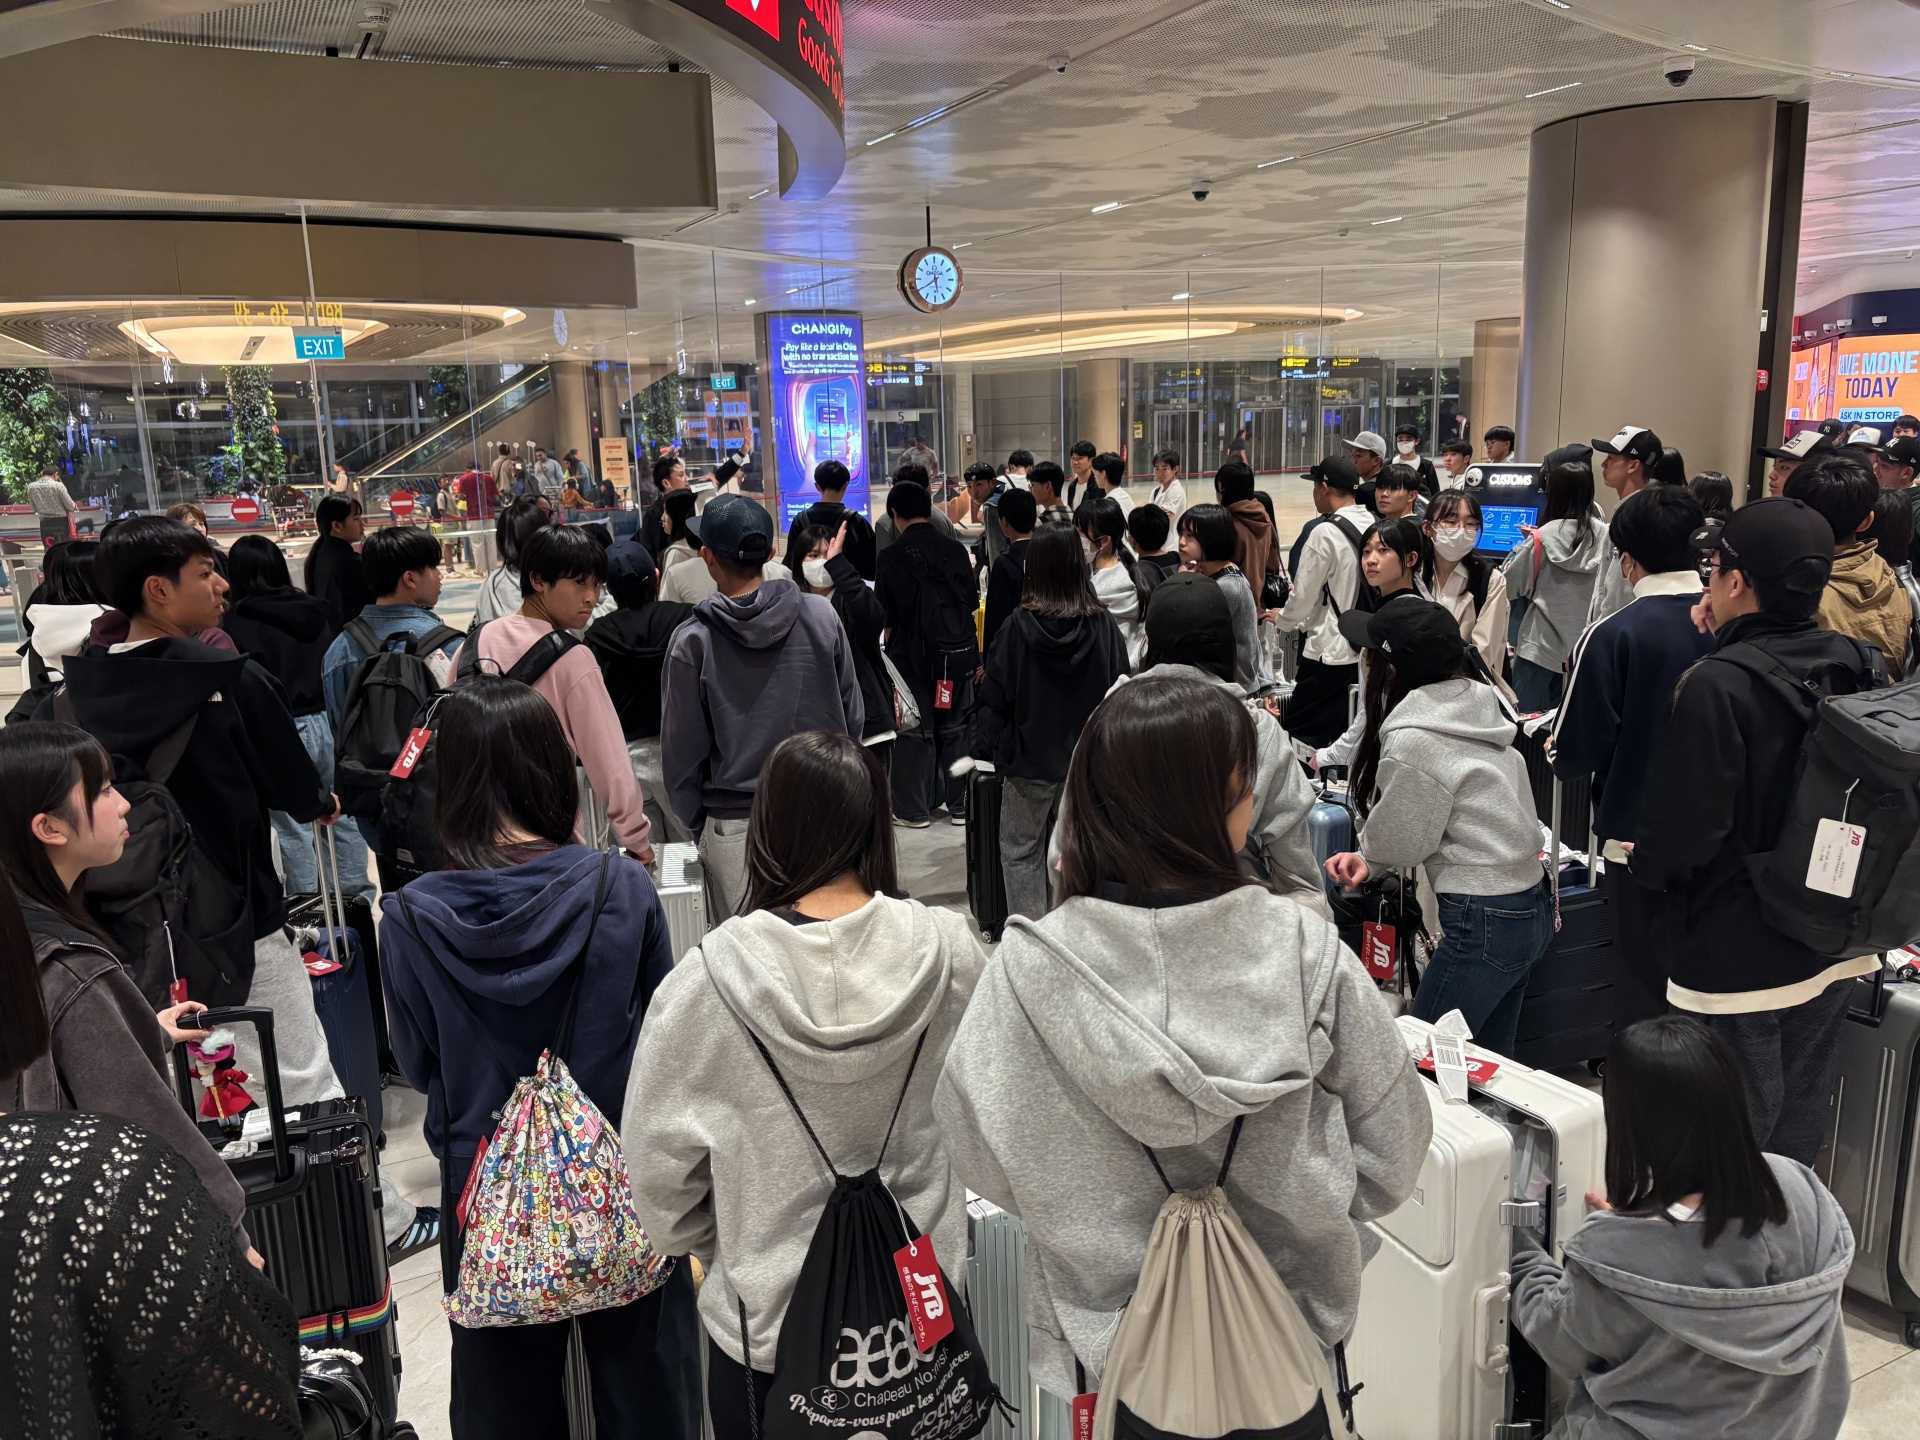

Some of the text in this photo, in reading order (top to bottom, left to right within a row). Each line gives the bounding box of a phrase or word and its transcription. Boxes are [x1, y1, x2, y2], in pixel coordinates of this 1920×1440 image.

[799, 17, 830, 87] Goods
[792, 323, 853, 338] CHANGI Pay
[302, 339, 335, 356] EXIT
[785, 343, 799, 354] Pay
[715, 378, 731, 388] EXIT
[1846, 377, 1899, 398] TODAY
[1489, 473, 1532, 486] CUSTOMS
[912, 1272, 944, 1320] JTB
[854, 1383, 912, 1408] Chapeau
[886, 1403, 916, 1428] pour
